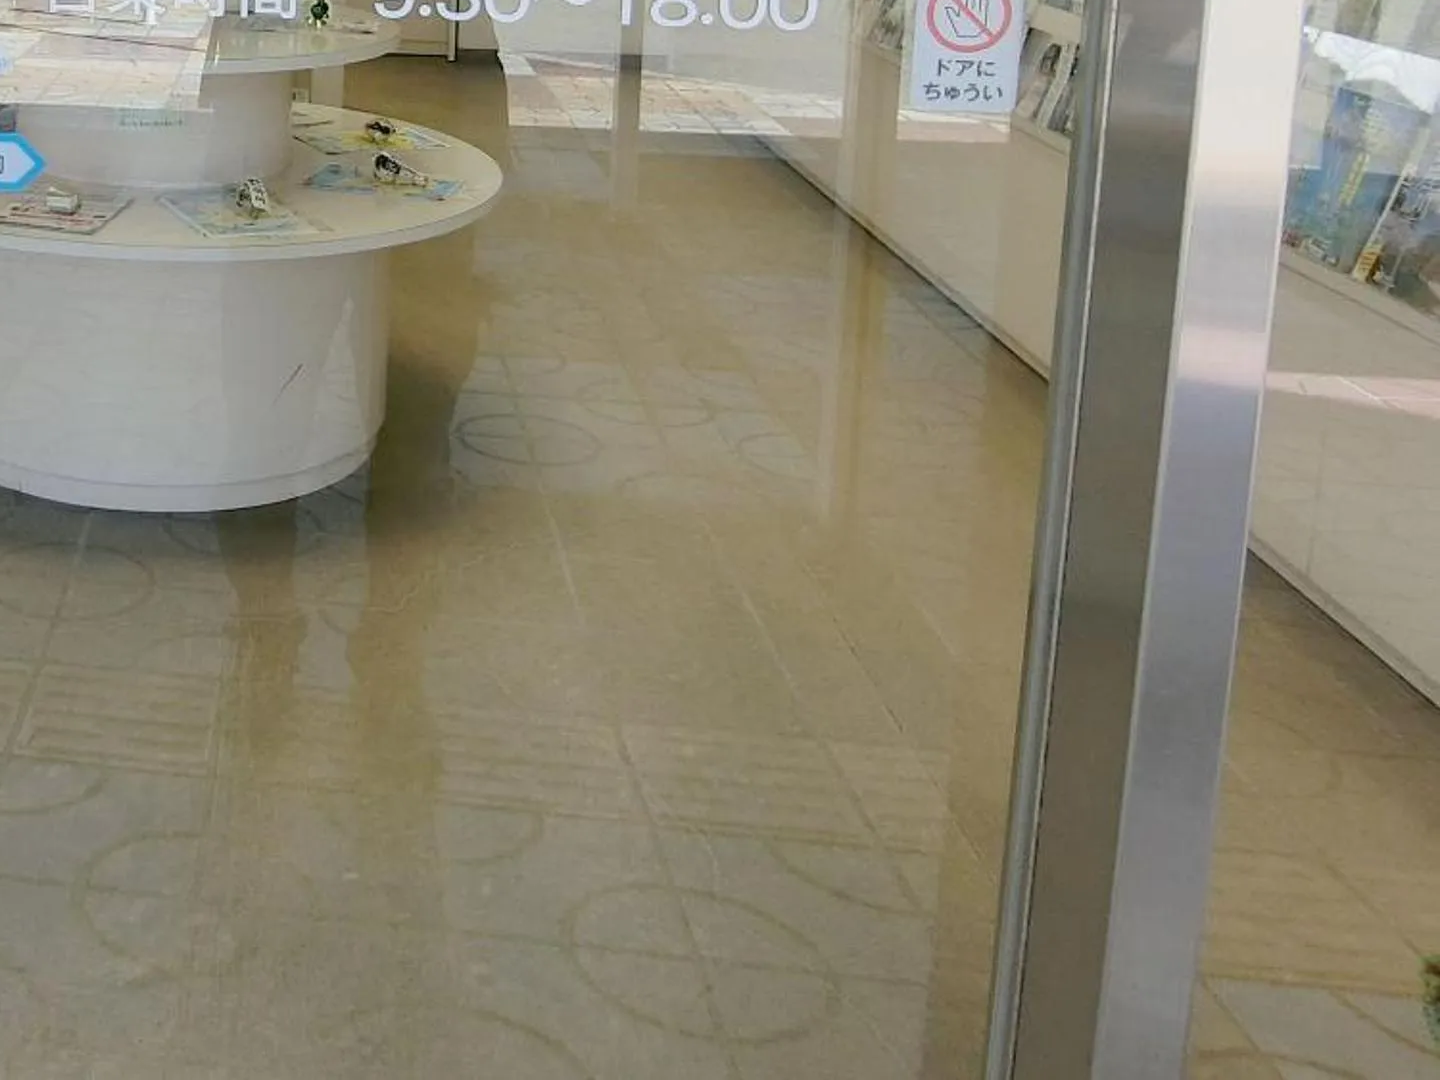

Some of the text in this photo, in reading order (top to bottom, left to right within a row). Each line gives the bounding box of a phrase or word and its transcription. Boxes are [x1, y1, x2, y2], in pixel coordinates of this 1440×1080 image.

[935, 59, 997, 78] ドアに
[923, 83, 1004, 102] ちゅうい
